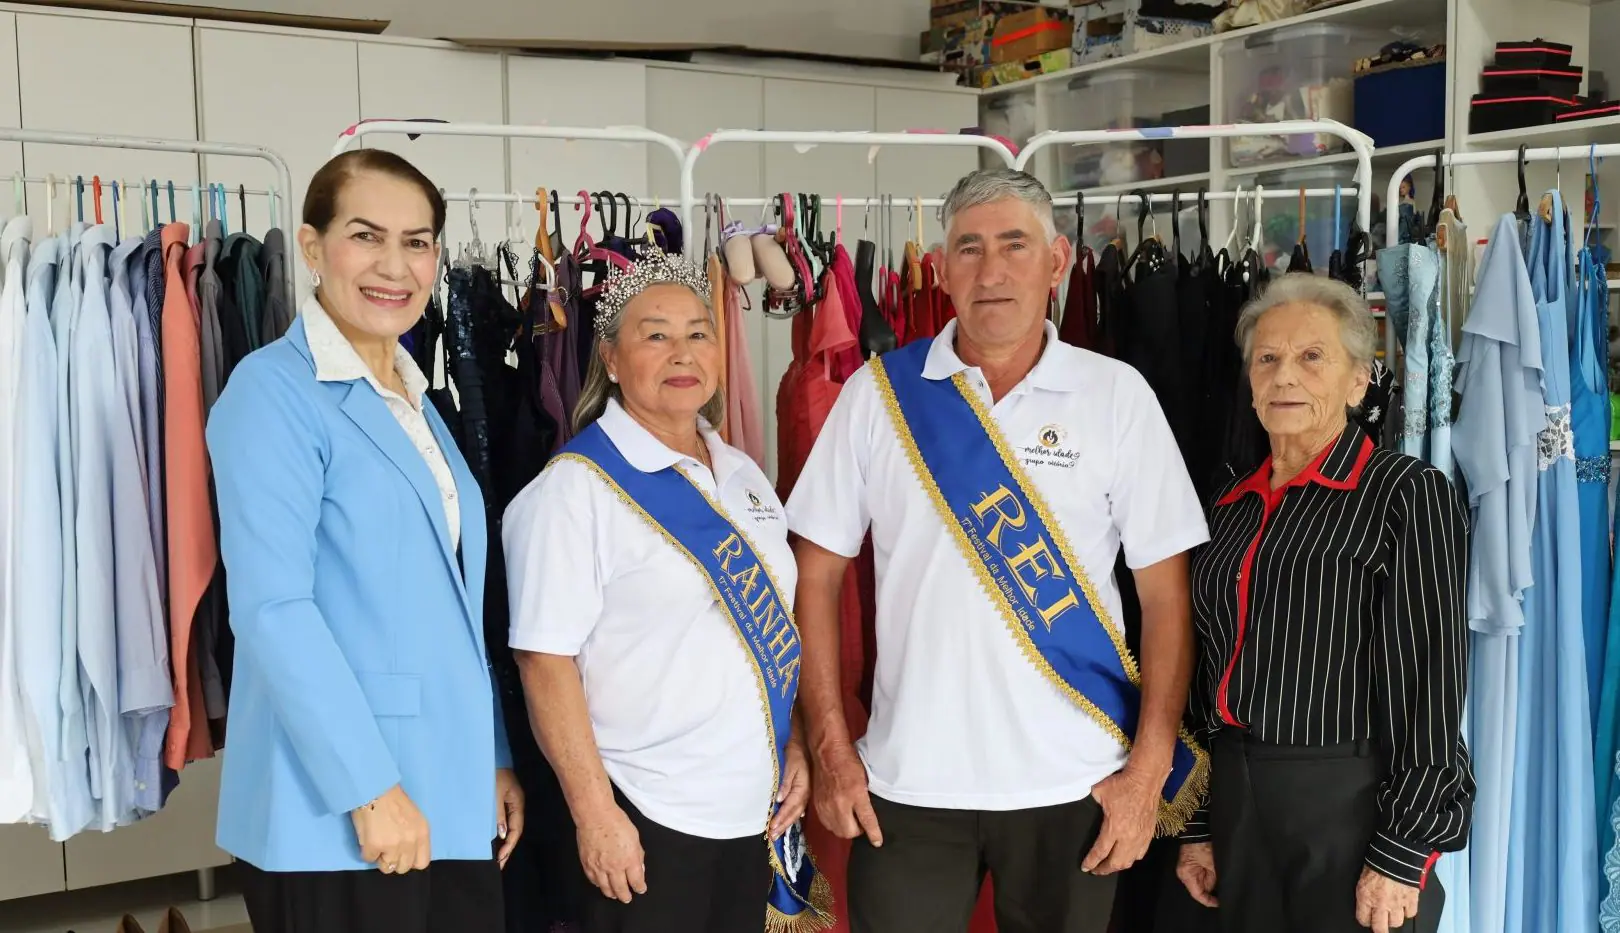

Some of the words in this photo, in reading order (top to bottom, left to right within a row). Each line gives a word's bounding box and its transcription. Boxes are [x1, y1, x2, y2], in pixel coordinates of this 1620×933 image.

[1019, 445, 1051, 456] melhor
[1023, 458, 1045, 467] grupo
[967, 528, 992, 561] Festival
[989, 562, 999, 574] da
[997, 576, 1019, 605] Melhor
[1017, 607, 1035, 631] Idade
[969, 483, 1080, 634] REI
[712, 532, 801, 699] RAINHA
[723, 587, 746, 620] Festival
[745, 622, 754, 635] da
[752, 635, 769, 663] Melhor
[765, 664, 777, 688] Idade
